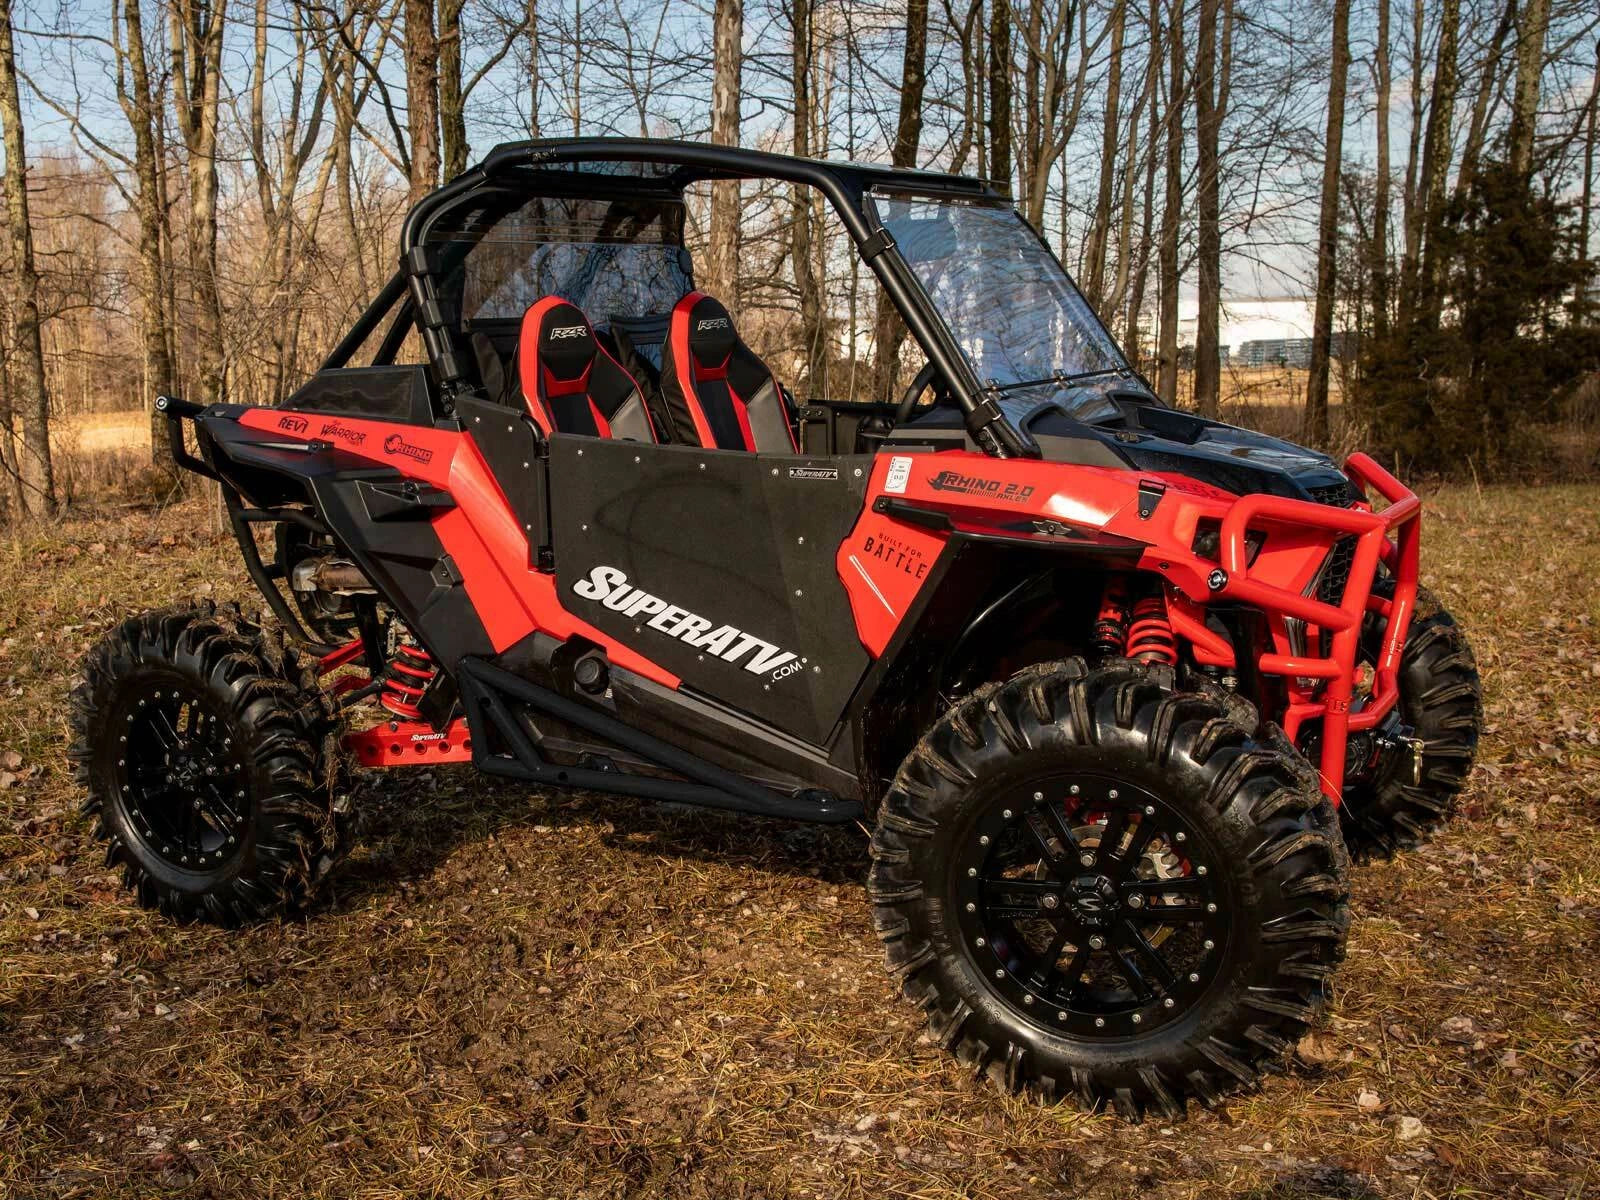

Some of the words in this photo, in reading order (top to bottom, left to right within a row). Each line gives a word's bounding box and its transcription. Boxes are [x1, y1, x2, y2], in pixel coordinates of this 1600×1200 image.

[550, 325, 587, 340] RZR
[698, 318, 728, 331] RZR
[321, 424, 367, 447] WARRIOR
[944, 474, 1001, 491] RHINO
[1004, 483, 1035, 497] 2.0
[878, 532, 902, 548] BUILT
[905, 545, 922, 559] FOR
[863, 536, 928, 579] BATTLE
